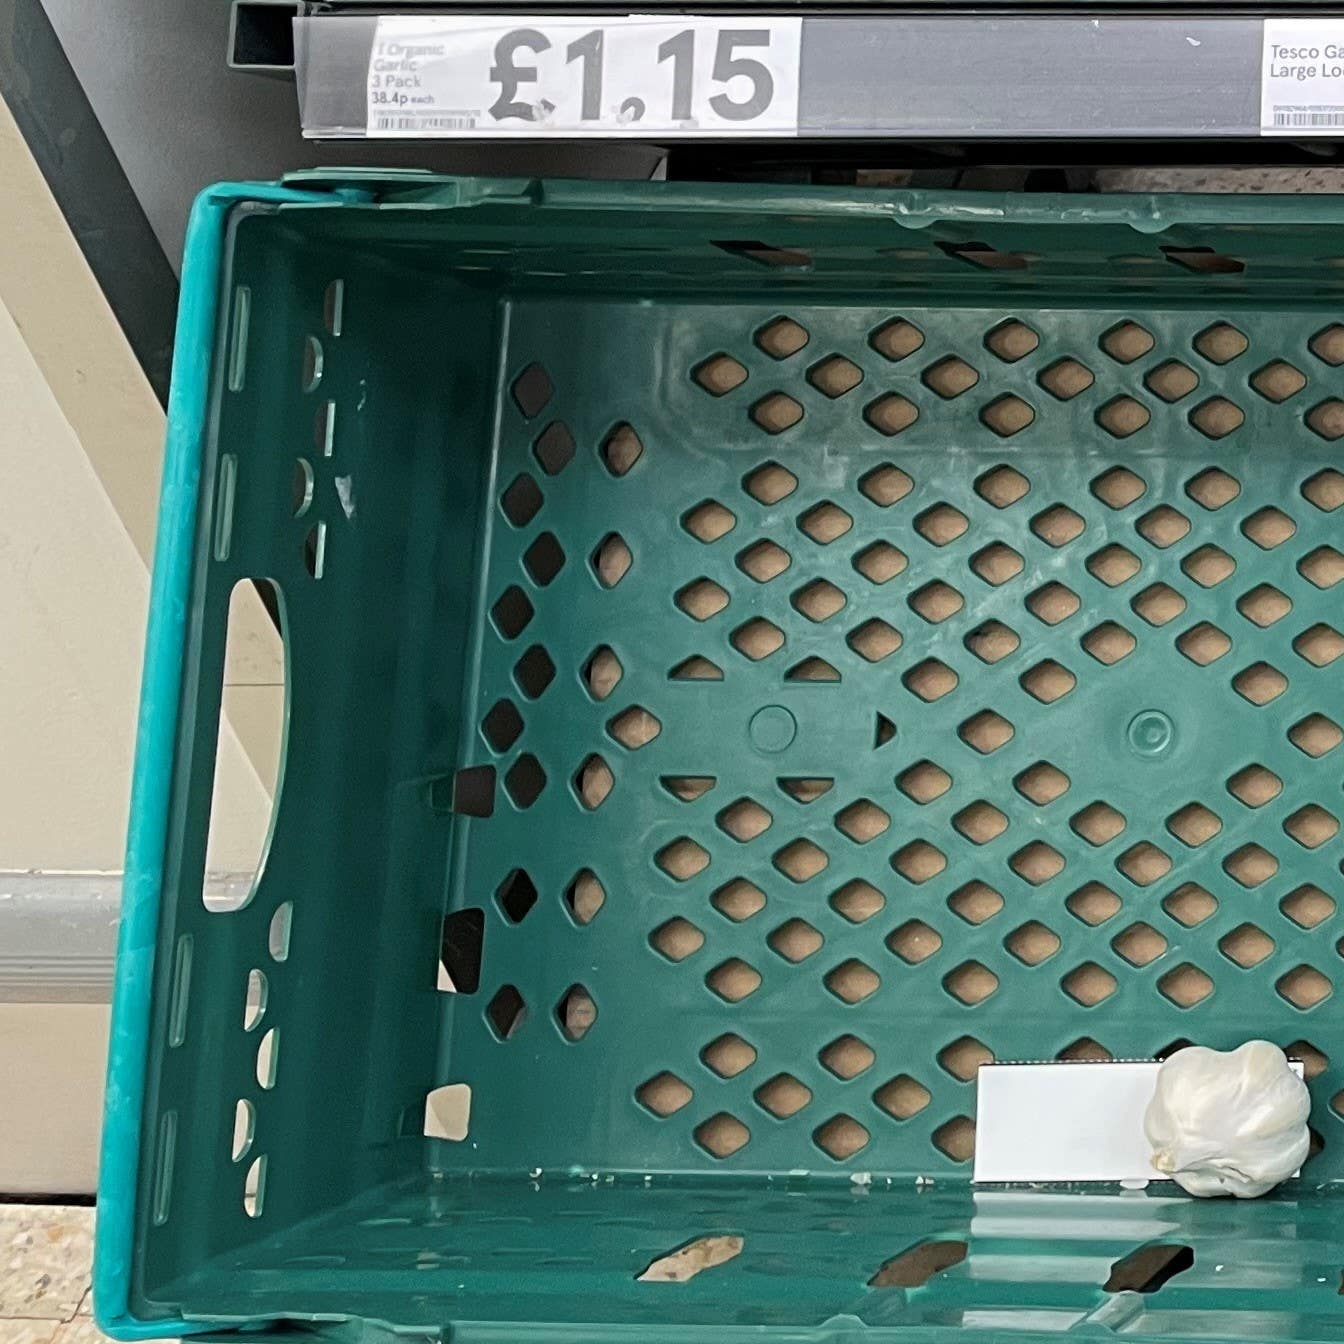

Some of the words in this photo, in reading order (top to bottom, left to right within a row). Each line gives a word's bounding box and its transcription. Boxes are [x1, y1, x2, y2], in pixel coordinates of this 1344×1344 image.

[1271, 44, 1320, 60] Tesco
[373, 59, 418, 72] Garlic
[1270, 63, 1317, 81] Large
[371, 74, 381, 88] 3
[385, 74, 421, 88] Pack
[487, 28, 775, 123] £1.15
[371, 91, 409, 107] 38.4p
